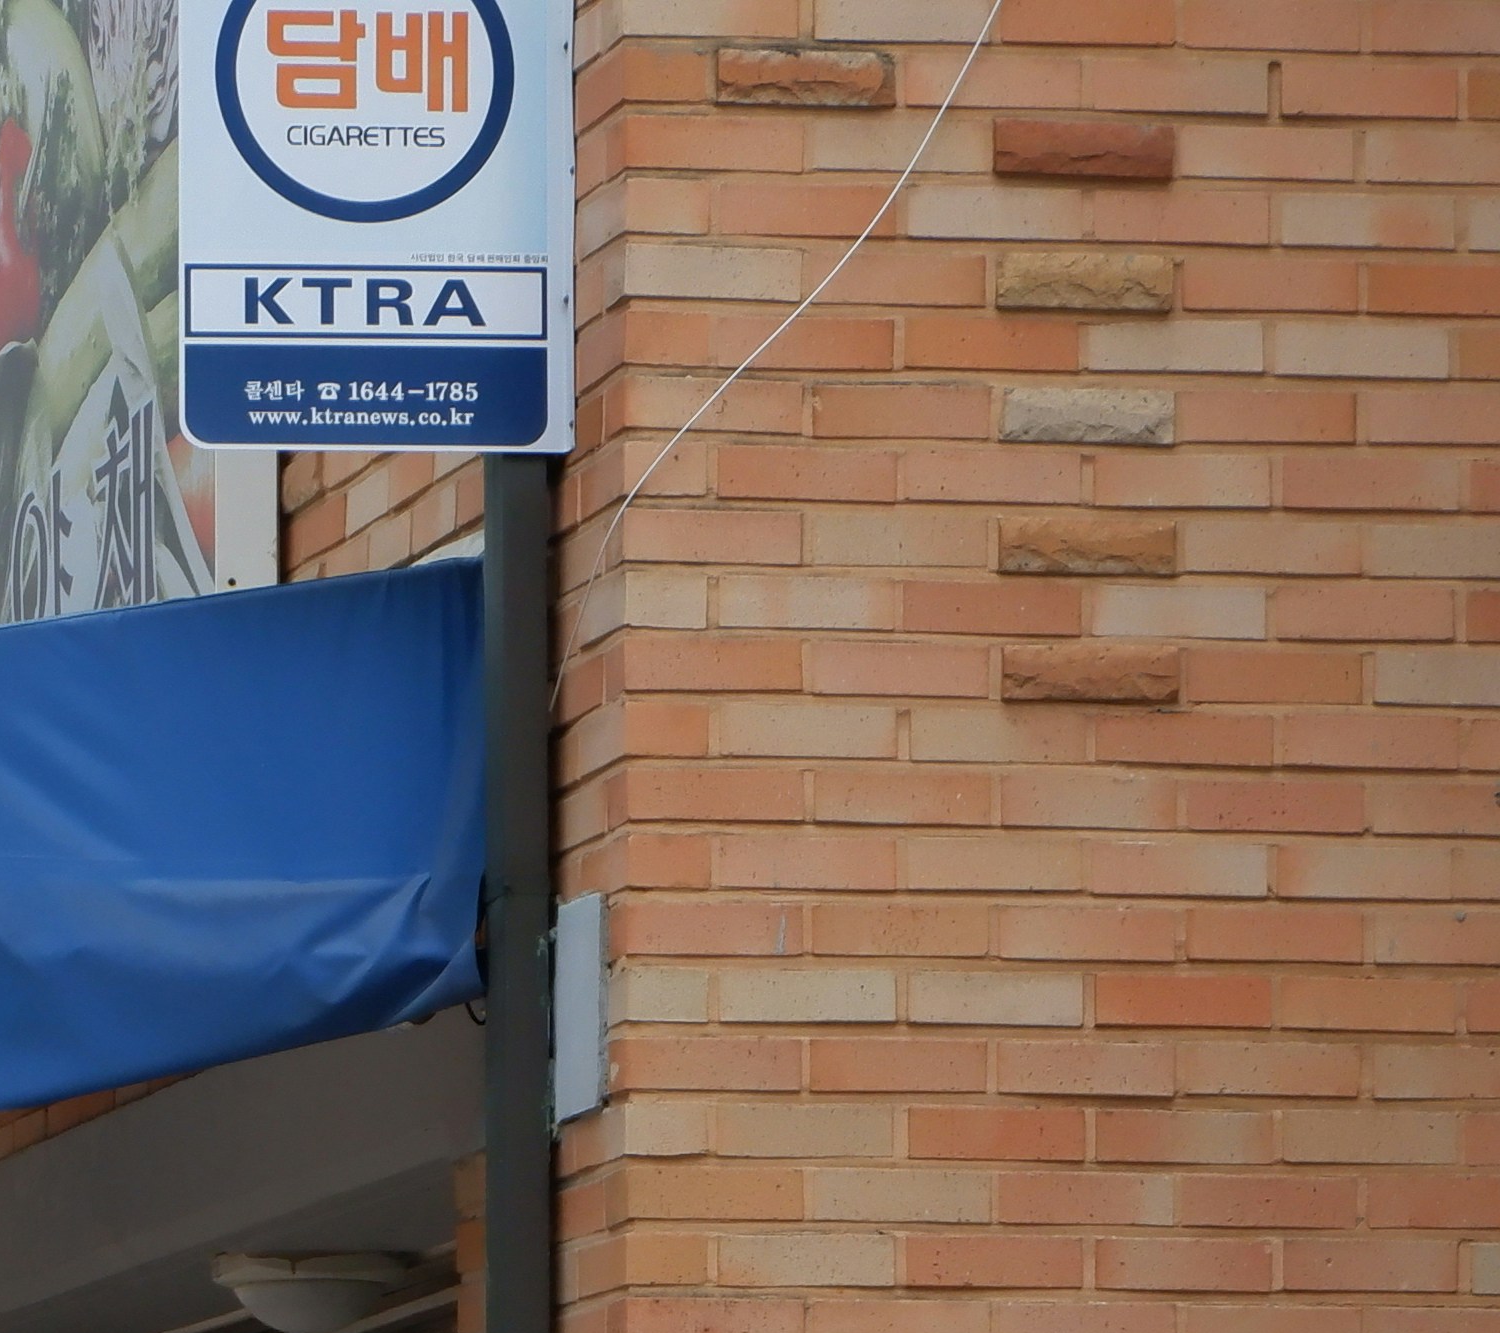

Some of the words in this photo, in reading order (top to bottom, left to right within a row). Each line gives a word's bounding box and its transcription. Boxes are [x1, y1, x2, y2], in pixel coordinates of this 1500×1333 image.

[267, 10, 469, 112] 담배
[287, 125, 445, 147] CIGARETTES
[244, 276, 487, 328] KTRA
[244, 380, 305, 402] 콜센타
[348, 381, 479, 402] 1644-1785
[248, 407, 475, 427] www.ktranews.co.kr
[12, 403, 156, 622] 야채
